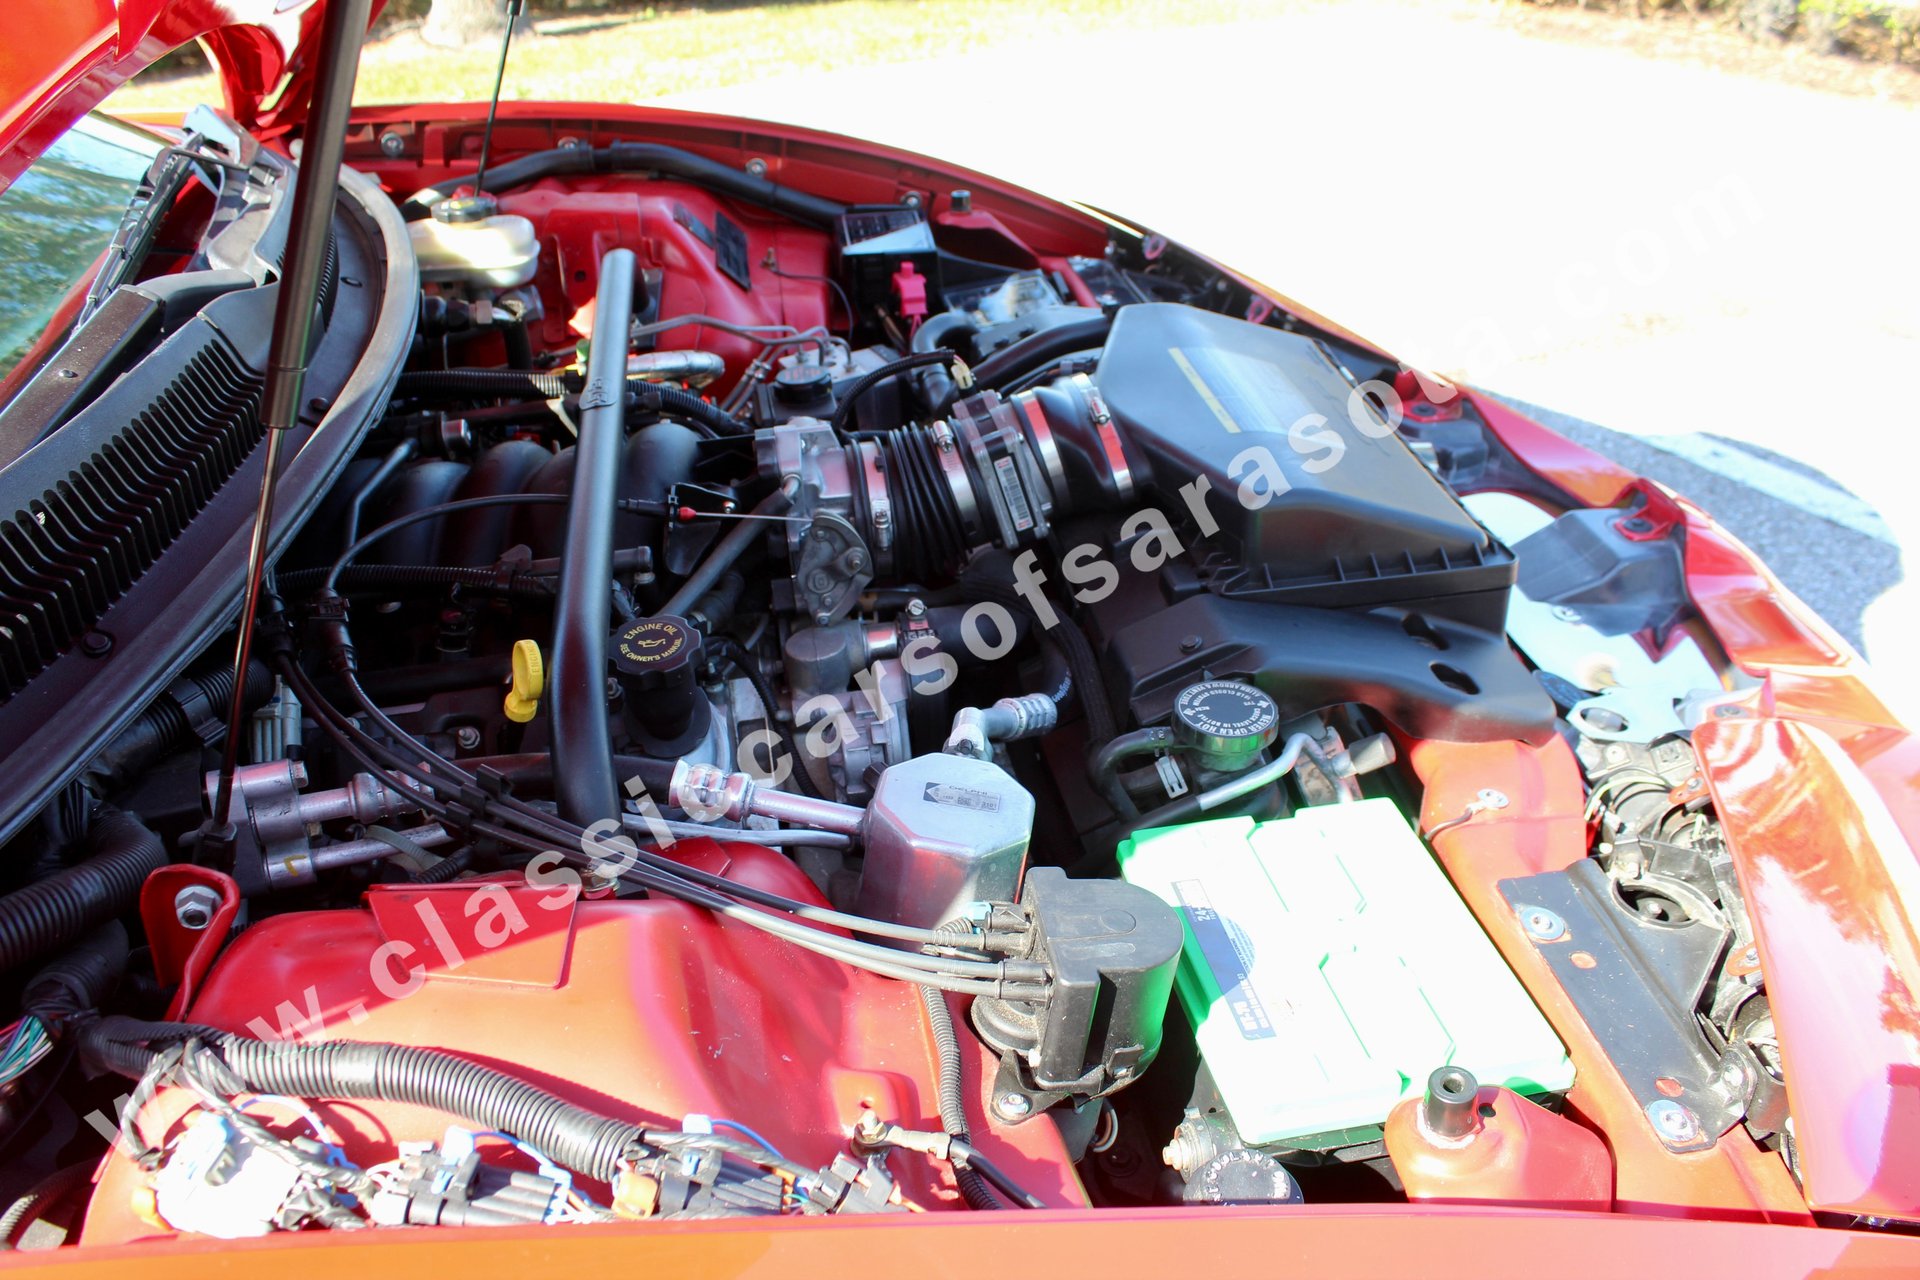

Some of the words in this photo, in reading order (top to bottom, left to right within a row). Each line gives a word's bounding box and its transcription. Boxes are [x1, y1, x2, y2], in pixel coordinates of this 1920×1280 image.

[624, 623, 663, 639] ENGINE
[663, 624, 678, 636] OIL
[620, 643, 629, 654] SEE
[626, 652, 660, 662] OWNER'S
[661, 637, 683, 658] MANUAL
[1196, 721, 1218, 734] HOT
[1249, 714, 1272, 732] NEVER
[1219, 727, 1248, 737] OPEN
